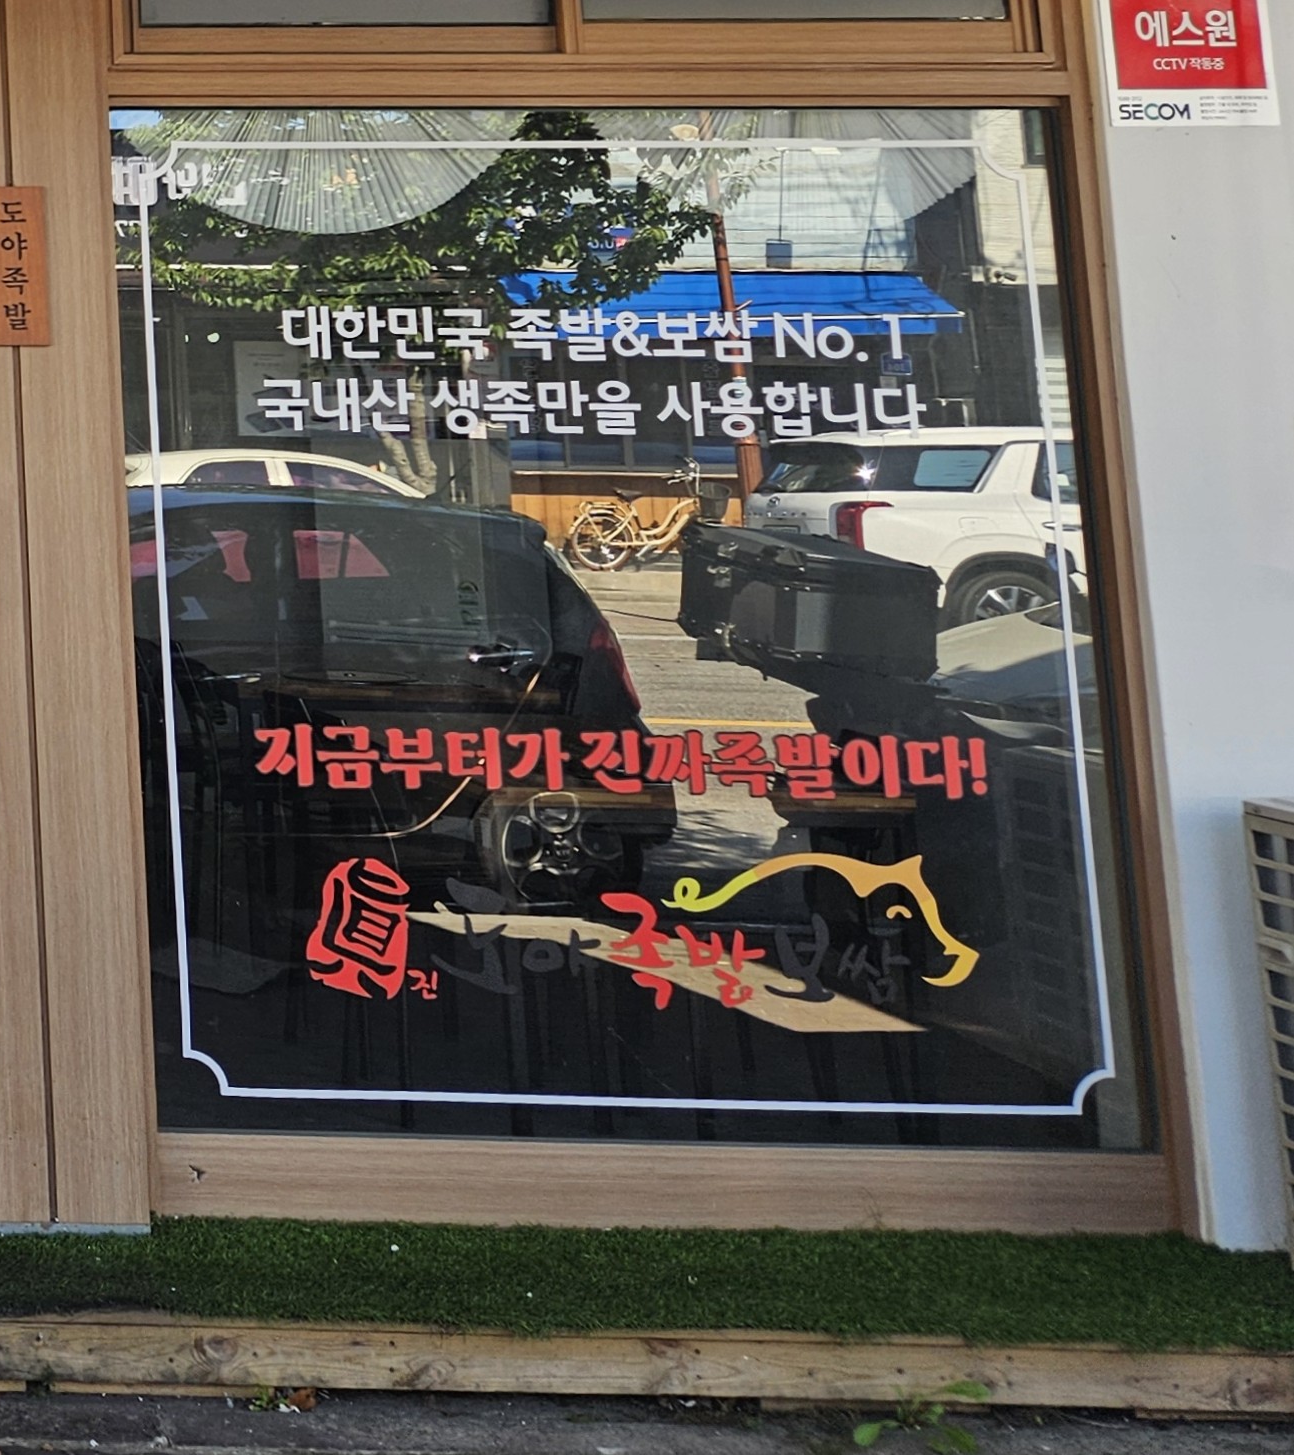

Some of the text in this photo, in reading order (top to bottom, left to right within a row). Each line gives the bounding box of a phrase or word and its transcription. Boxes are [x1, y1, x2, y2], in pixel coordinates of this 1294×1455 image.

[1134, 10, 1237, 47] 에스원
[1153, 58, 1225, 70] CCTV 작동중
[1119, 103, 1191, 120] SECOM
[0, 201, 31, 330] 도야족발
[280, 305, 491, 363] 대한민국
[509, 308, 759, 363] 족발&보쌈
[256, 377, 926, 438] 국내산 생족만을 사용합니다
[255, 724, 988, 801] 지금부터가 진짜족발이다!
